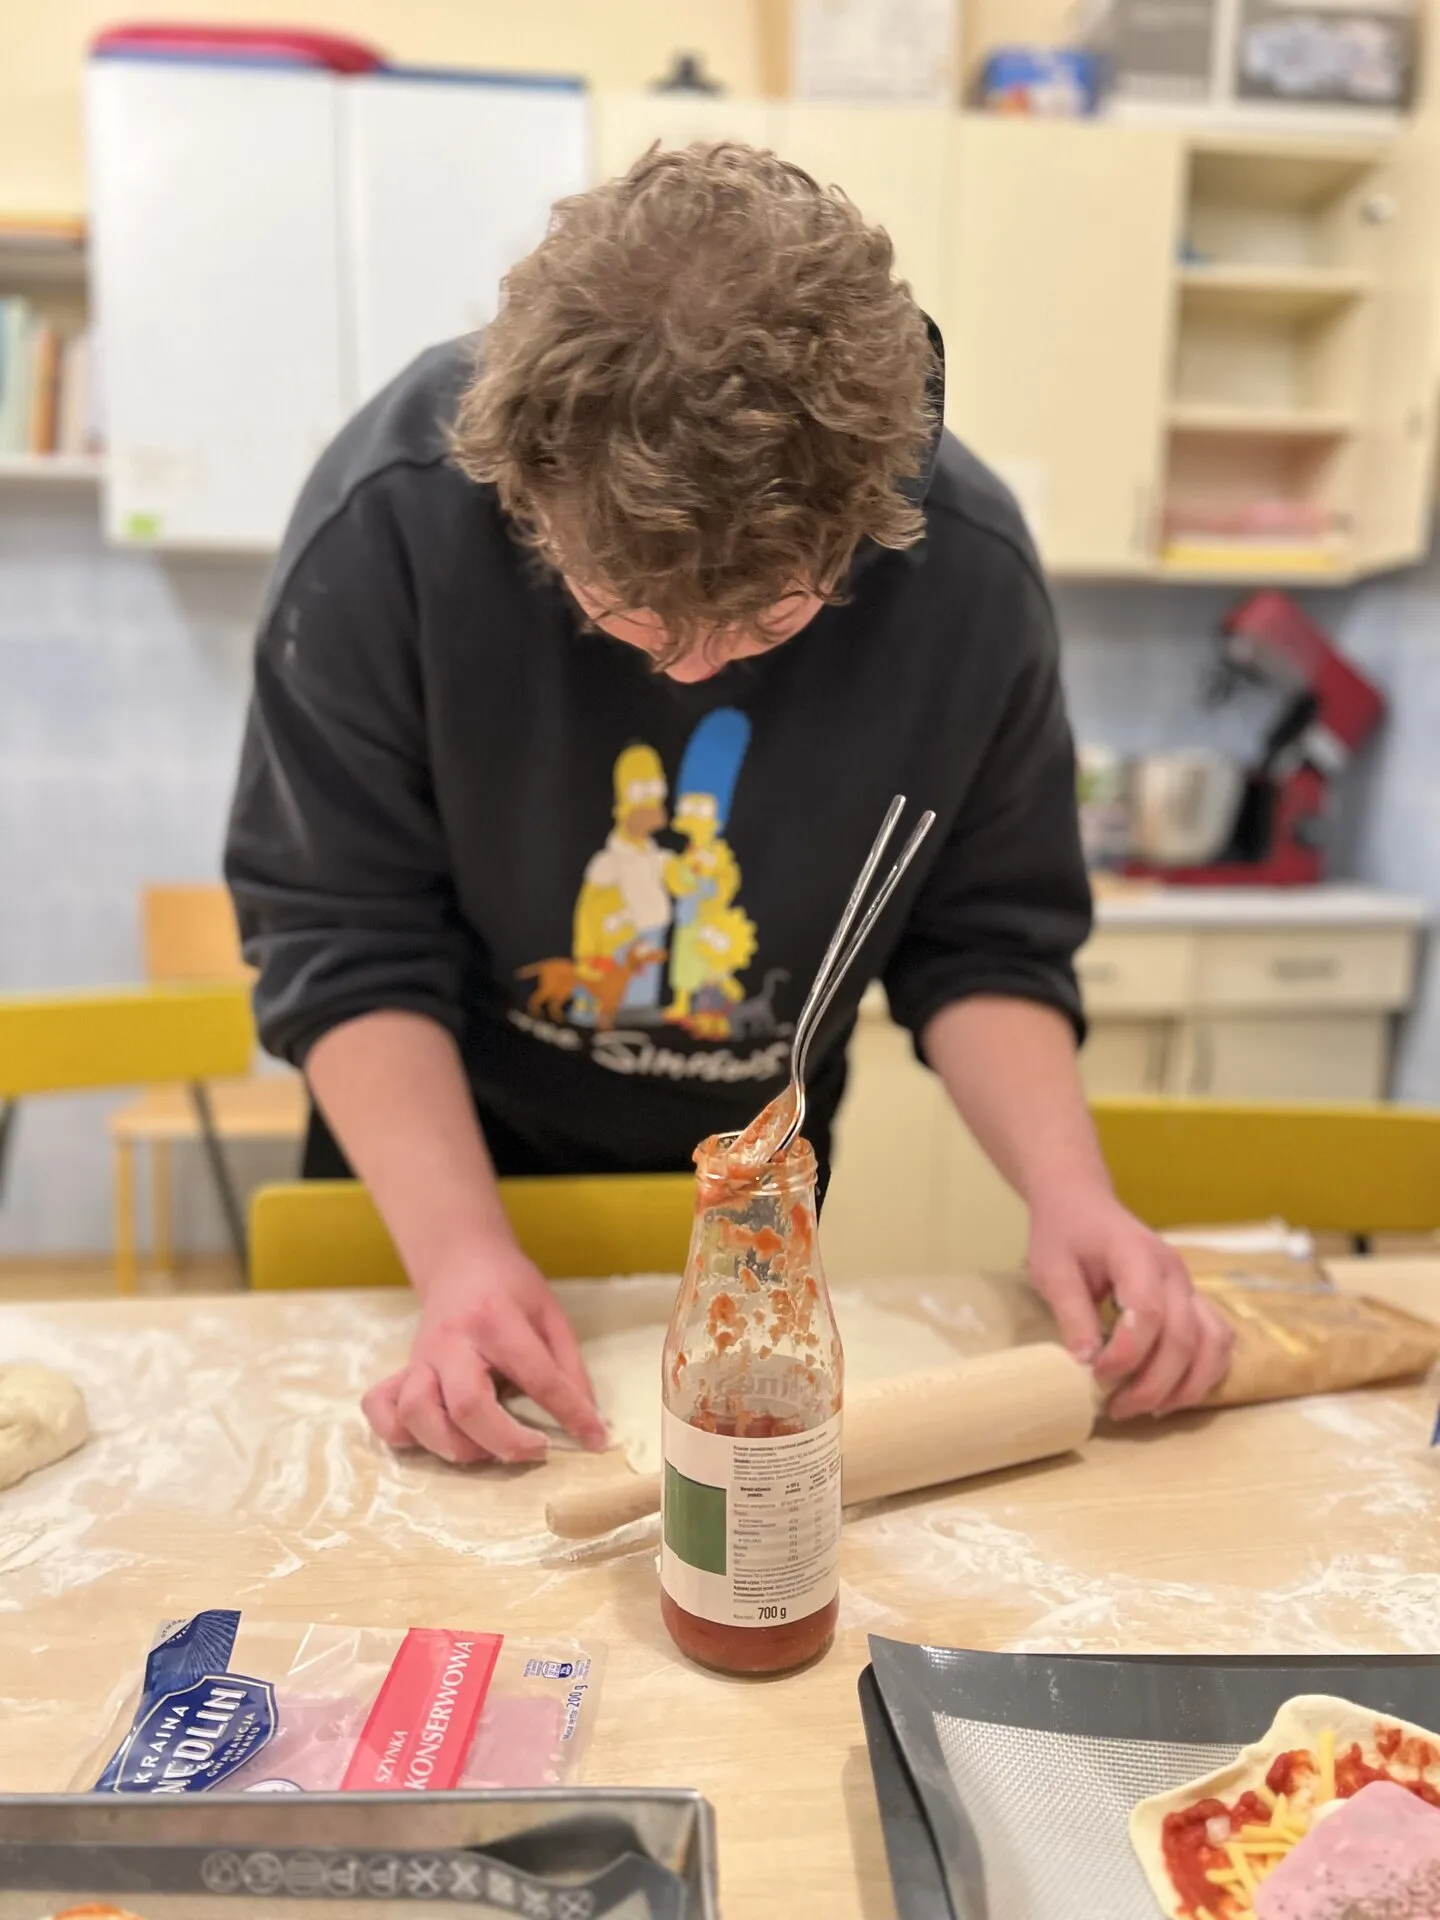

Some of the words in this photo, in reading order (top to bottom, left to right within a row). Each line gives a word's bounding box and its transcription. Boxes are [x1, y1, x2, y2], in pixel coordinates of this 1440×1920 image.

[758, 1606, 778, 1620] 700
[780, 1607, 787, 1619] g
[404, 1641, 475, 1791] KONSERWOWA
[566, 1692, 583, 1708] 200
[133, 1706, 190, 1784] KRAINA
[206, 1712, 257, 1778] GWARANCJA
[229, 1726, 261, 1763] SMAKU
[374, 1730, 409, 1784] SZYNKA
